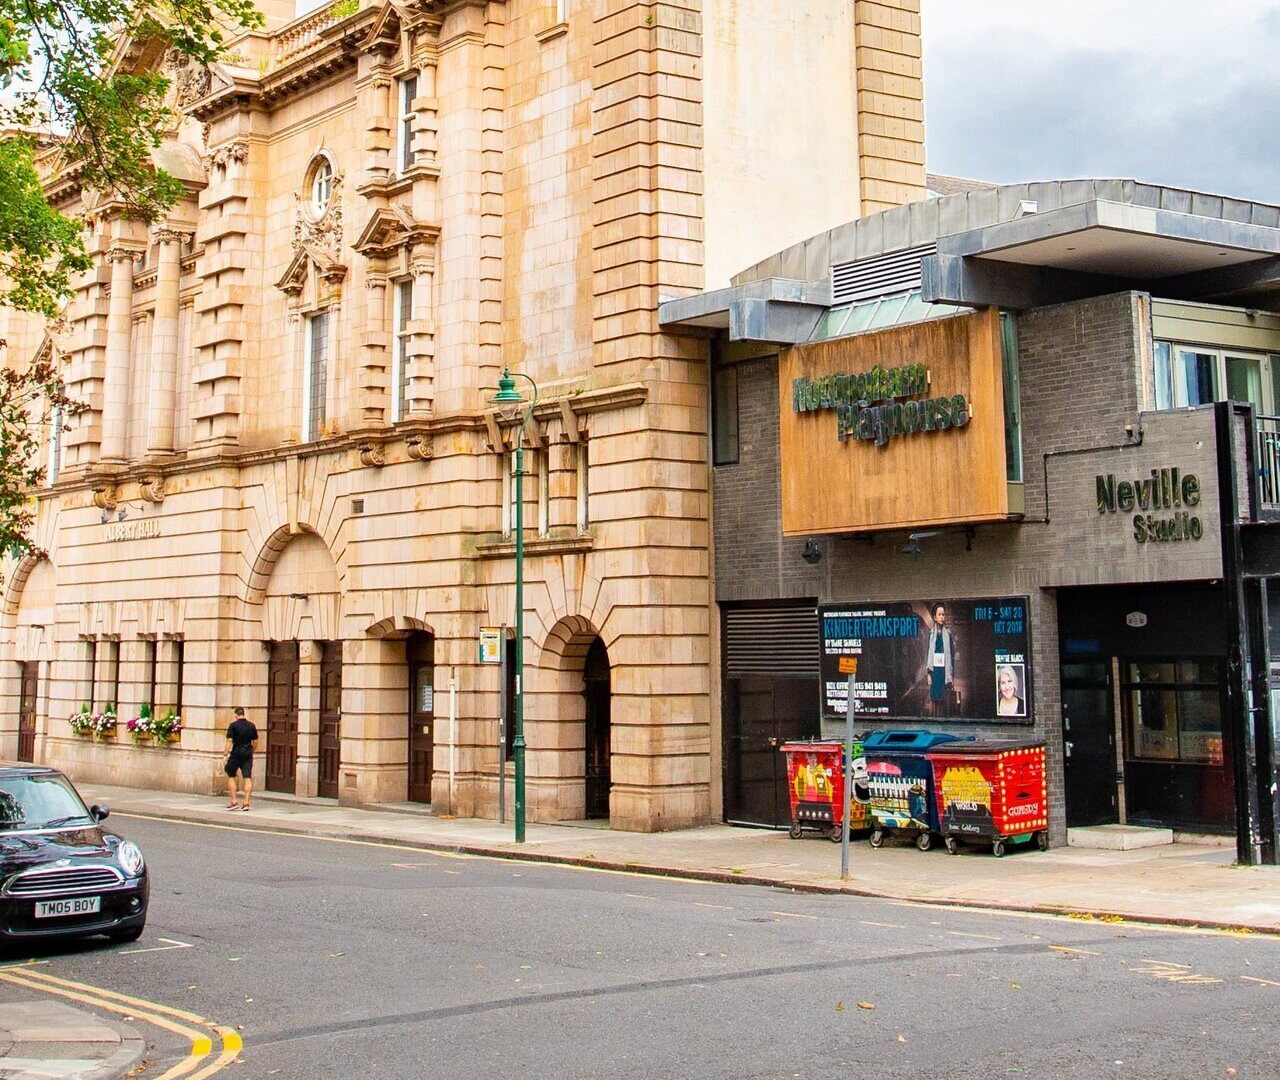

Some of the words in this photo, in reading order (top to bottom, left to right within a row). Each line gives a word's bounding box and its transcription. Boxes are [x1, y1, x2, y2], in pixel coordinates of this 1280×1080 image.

[793, 362, 927, 412] Nottingham
[837, 393, 968, 446] Playhouse
[1096, 467, 1201, 513] Neville
[106, 523, 136, 542] ALBERT
[138, 520, 160, 539] HALL
[1133, 511, 1204, 543] Studio
[74, 899, 96, 912] BOY
